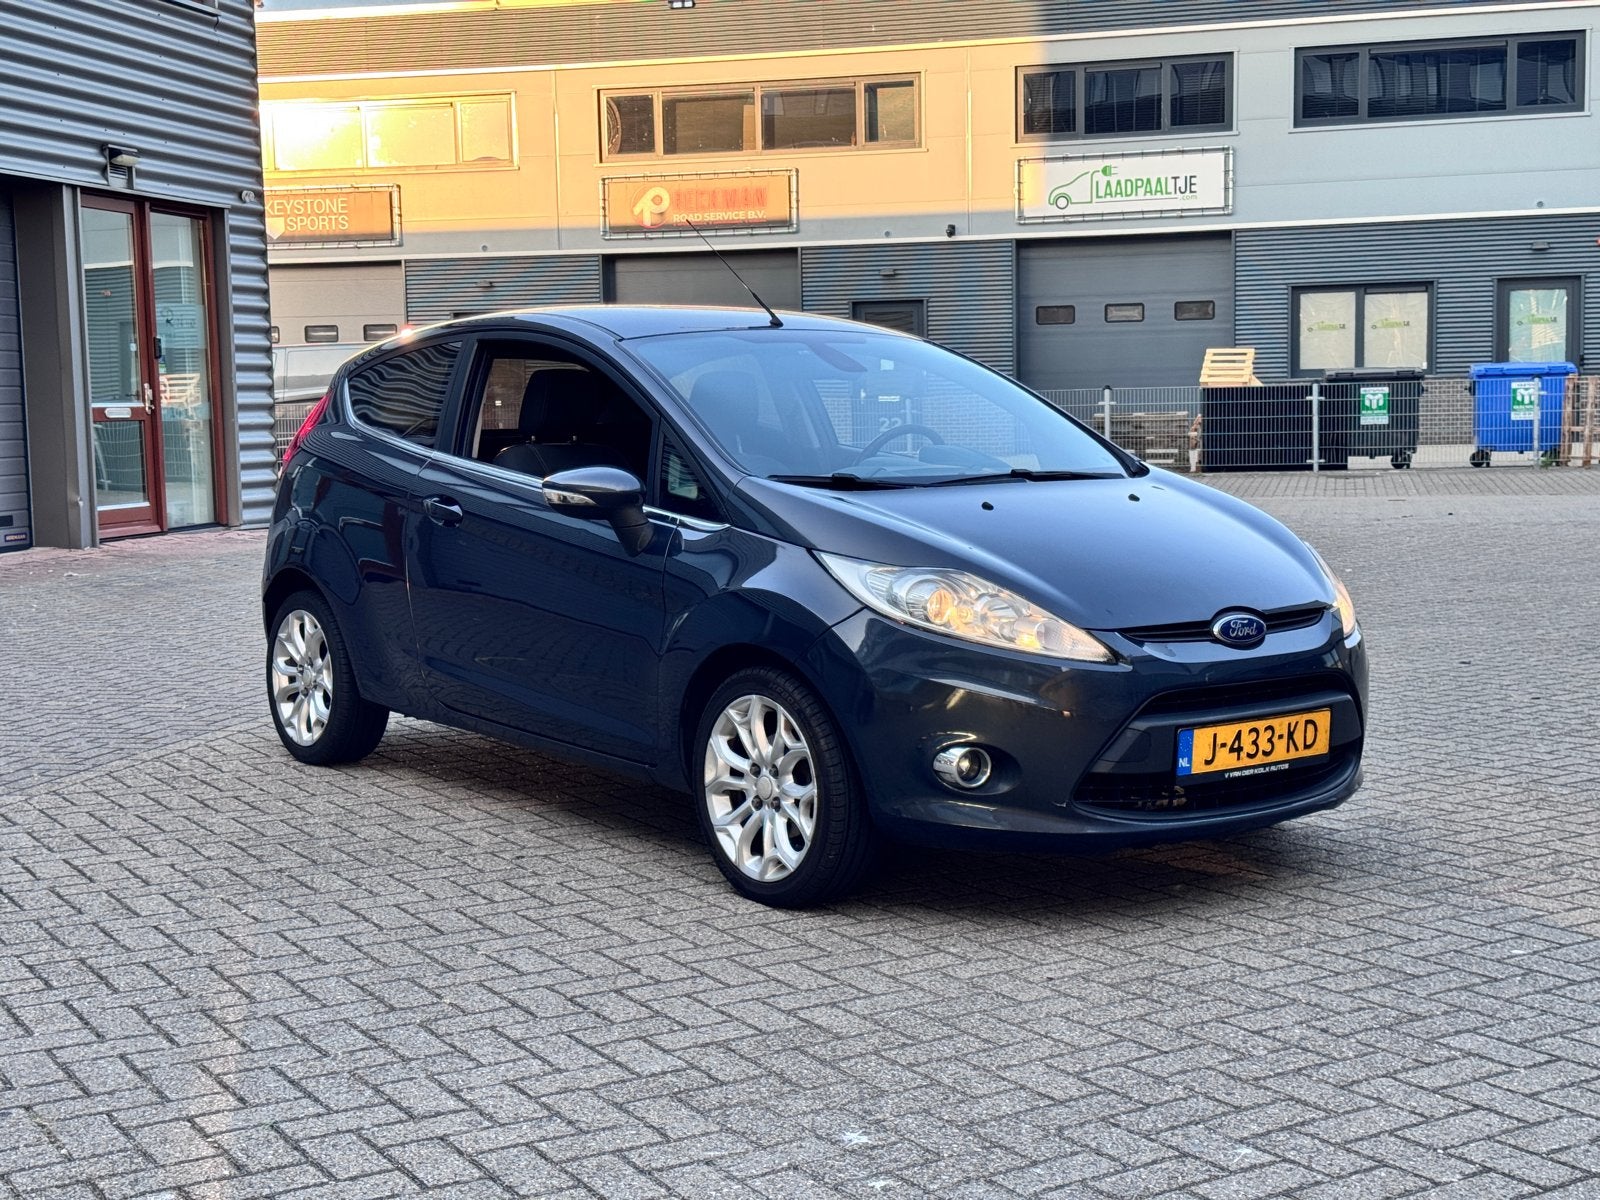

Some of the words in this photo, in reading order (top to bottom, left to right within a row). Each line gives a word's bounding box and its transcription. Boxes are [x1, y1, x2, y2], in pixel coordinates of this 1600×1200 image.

[1095, 175, 1197, 199] LAADPAALTJE
[265, 198, 348, 215] KEYSTONE
[286, 215, 349, 231] SPORTS
[673, 213, 702, 223] ROAD
[704, 211, 746, 221] SERVICE
[748, 210, 767, 219] B.V.
[1229, 619, 1257, 637] Ford
[1204, 719, 1318, 766] J-433-KD
[1178, 757, 1190, 768] NL
[1230, 770, 1241, 778] VAN
[1242, 768, 1254, 776] DER
[1255, 766, 1270, 774] KOLK
[1270, 763, 1289, 772] AUTOS
